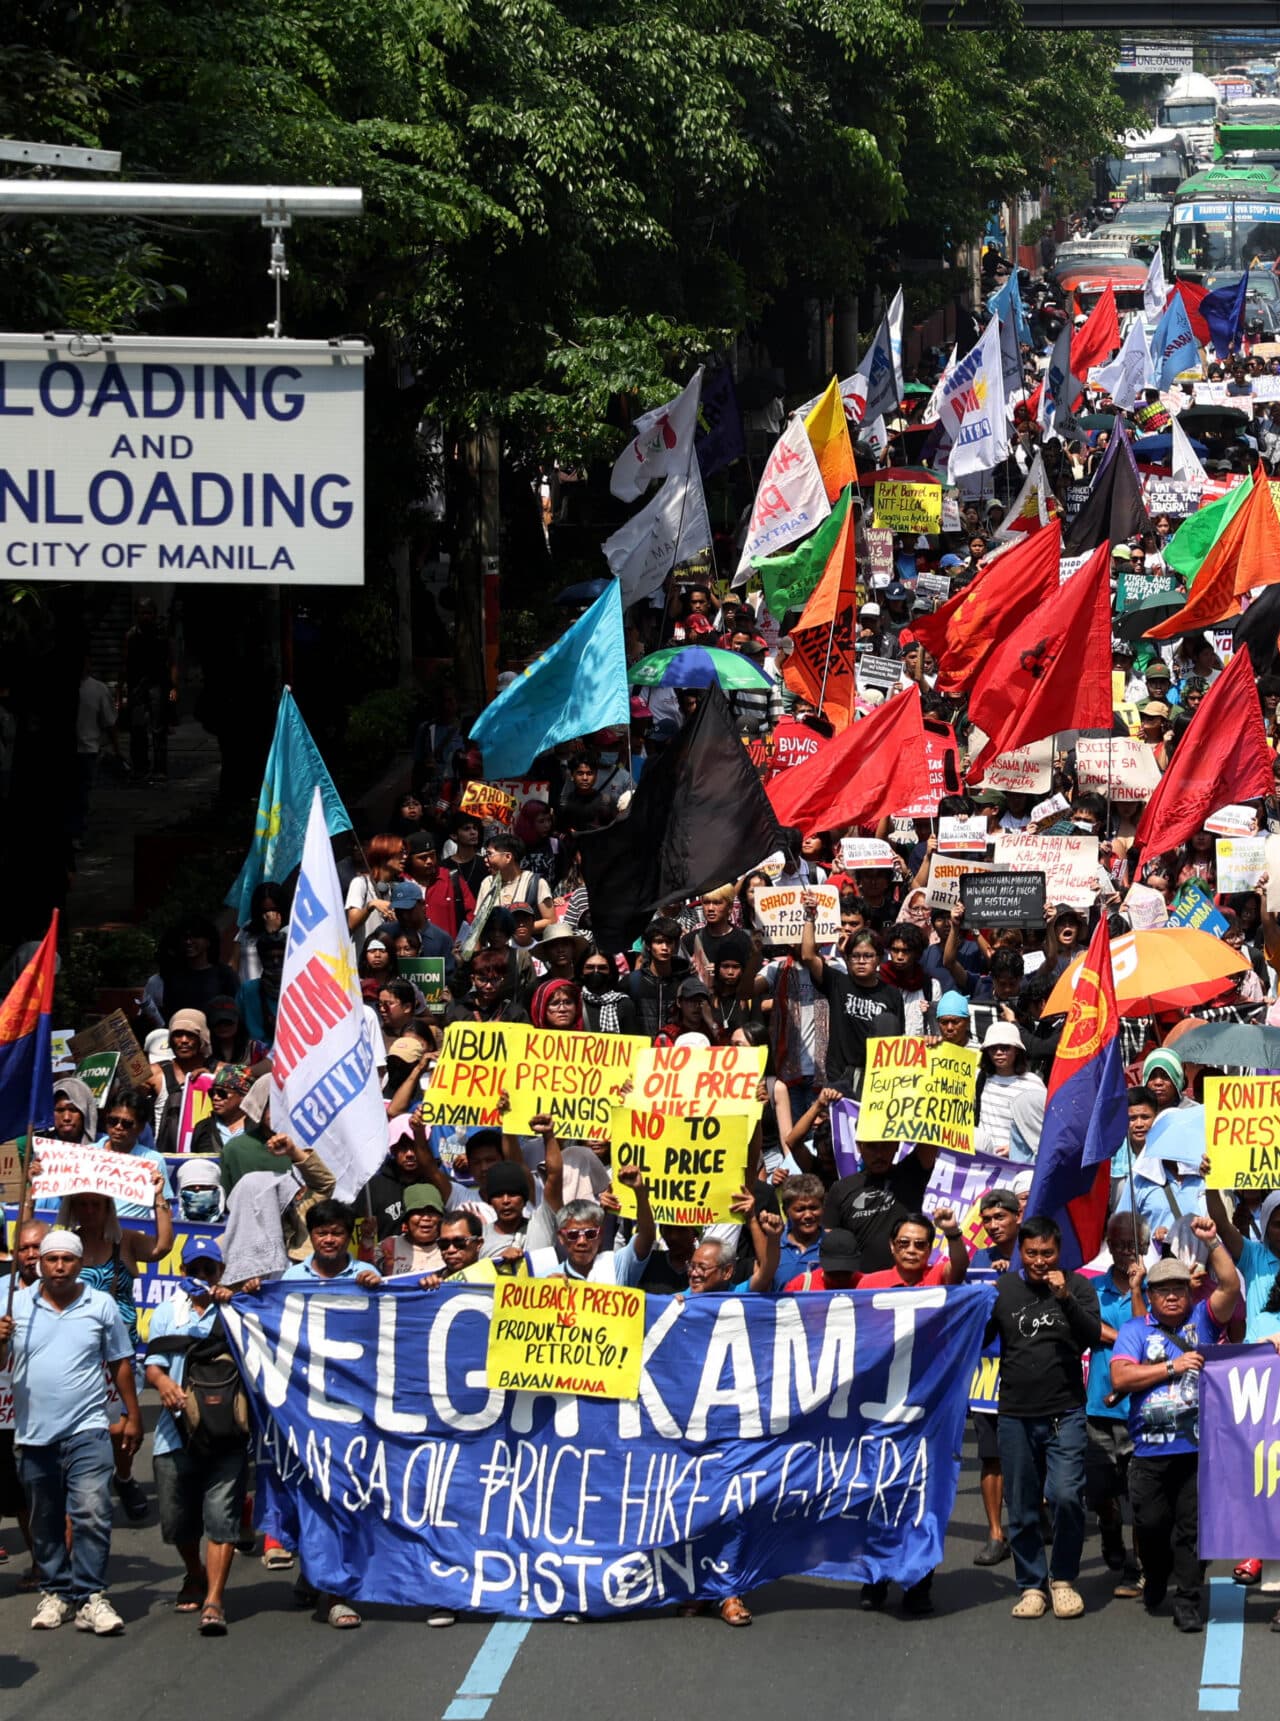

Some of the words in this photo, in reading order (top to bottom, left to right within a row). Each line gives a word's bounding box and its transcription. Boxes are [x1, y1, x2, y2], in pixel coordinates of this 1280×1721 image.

[0, 361, 306, 422] LOADING
[110, 434, 195, 460] AND
[6, 542, 91, 568] CITY
[102, 543, 147, 569] OF
[158, 545, 296, 571] MANILA
[778, 736, 818, 754] BUWIS
[760, 892, 796, 912] SAHOD
[524, 1032, 632, 1067] KONTROLIN
[652, 1046, 691, 1071] NO
[706, 1046, 738, 1071] TO
[872, 1038, 928, 1069] AYUDA
[930, 1057, 960, 1076] para
[960, 1061, 972, 1078] sa
[515, 1062, 602, 1095] PRESYO
[644, 1072, 682, 1099] OIL
[688, 1072, 760, 1100] PRICE
[870, 1071, 924, 1099] Tsuper
[925, 1077, 941, 1094] at
[420, 1101, 480, 1126] BAYAN
[868, 1100, 884, 1112] na
[886, 1096, 974, 1126] OPEREYTOR!
[630, 1112, 665, 1140] NO
[684, 1118, 722, 1140] TO
[881, 1120, 940, 1142] BAYAN
[941, 1126, 970, 1151] MUNA
[618, 1142, 651, 1174] OIL
[664, 1149, 727, 1176] PRICE
[500, 1282, 579, 1312] ROLLBACK
[582, 1287, 640, 1317] PRESYO
[496, 1318, 608, 1344] PRODUKTONG
[556, 1312, 576, 1327] NG
[524, 1342, 629, 1370] PETROLYO!
[618, 1287, 948, 1442] KAMI
[498, 1372, 554, 1388] BAYAN
[554, 1376, 608, 1394] MUNA
[402, 1442, 460, 1528] OIL
[618, 1450, 724, 1546] HIKE
[720, 1470, 768, 1517] AT
[772, 1435, 928, 1529] GIYERA
